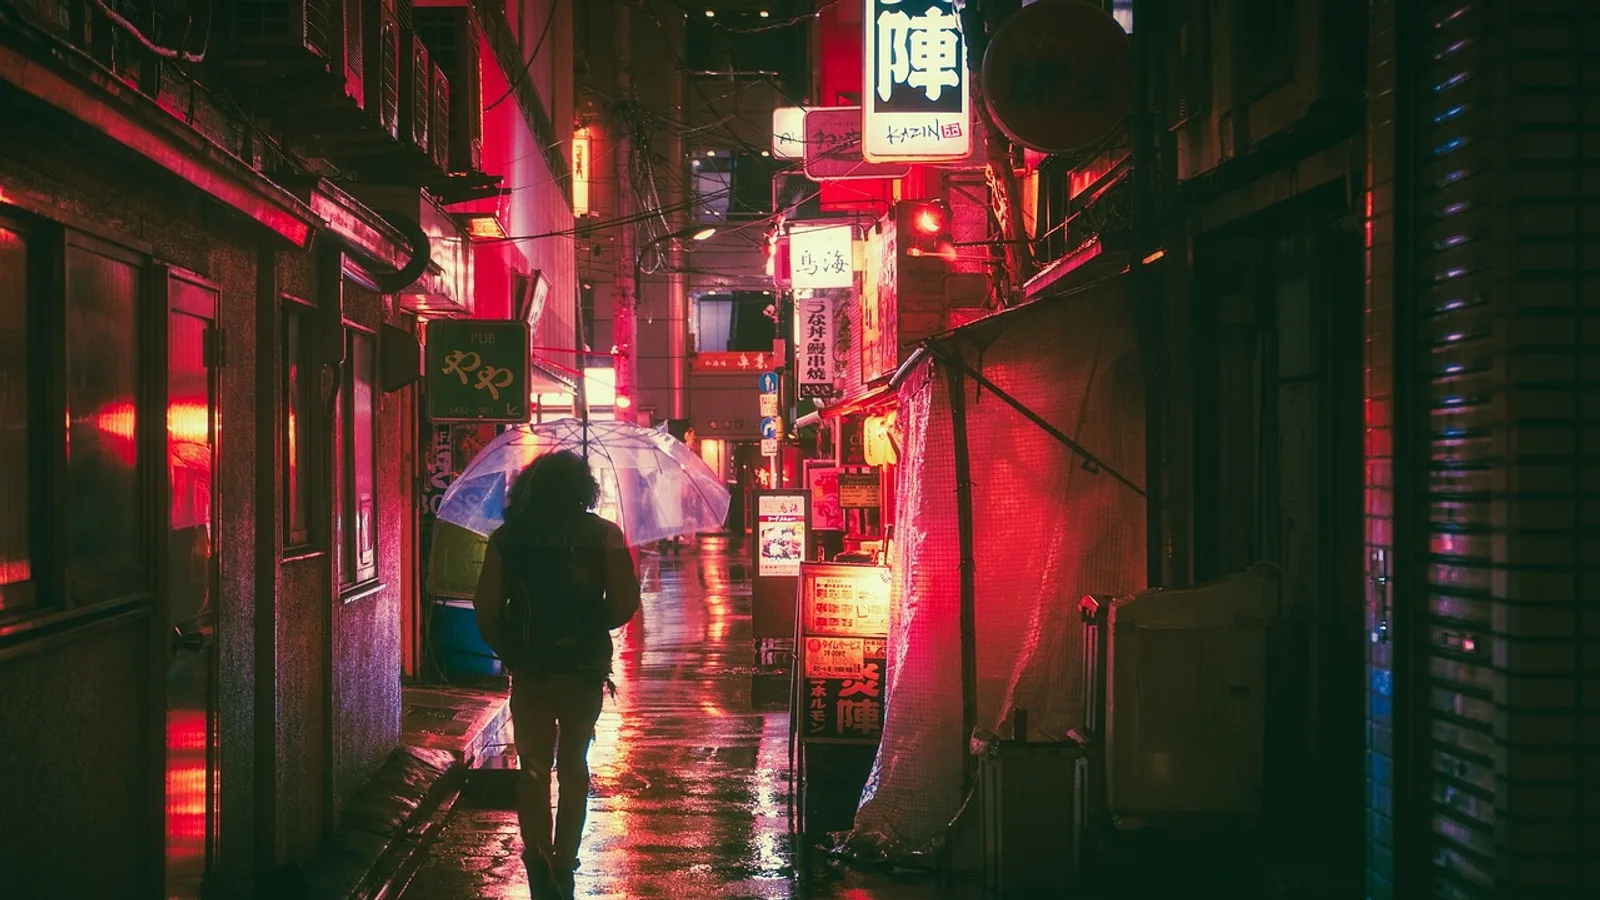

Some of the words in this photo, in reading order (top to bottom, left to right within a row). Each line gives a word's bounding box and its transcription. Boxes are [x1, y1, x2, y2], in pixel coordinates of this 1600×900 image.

[877, 0, 960, 102] 陣
[887, 119, 941, 145] KAZIN
[470, 333, 495, 344] PUB
[806, 300, 827, 381] うな丼・鰻串焼
[441, 350, 514, 400] やや
[821, 640, 862, 650] タイムサービス
[810, 680, 827, 734] ホルモン
